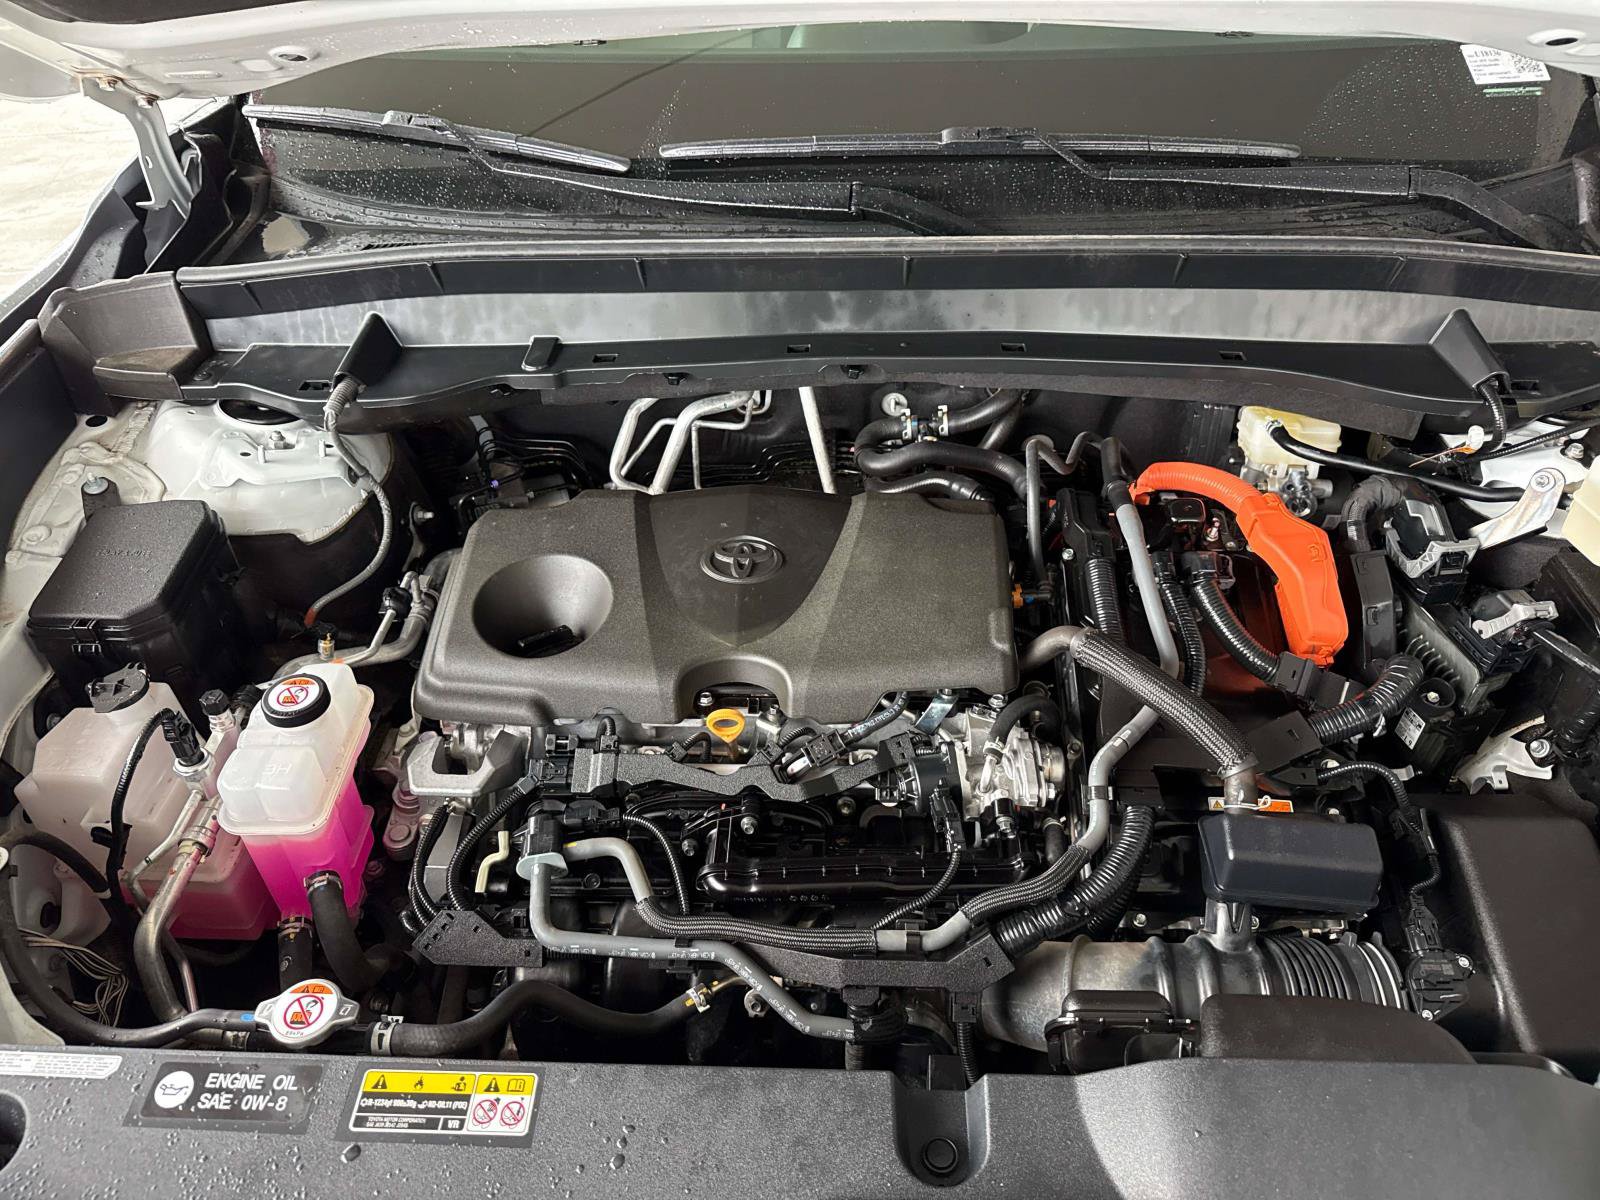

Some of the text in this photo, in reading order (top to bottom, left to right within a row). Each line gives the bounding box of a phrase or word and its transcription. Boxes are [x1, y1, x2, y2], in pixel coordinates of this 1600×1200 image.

[204, 1072, 298, 1091] ENGINE OIL
[197, 1092, 288, 1111] SAE 0W-8
[447, 1119, 461, 1129] VR
